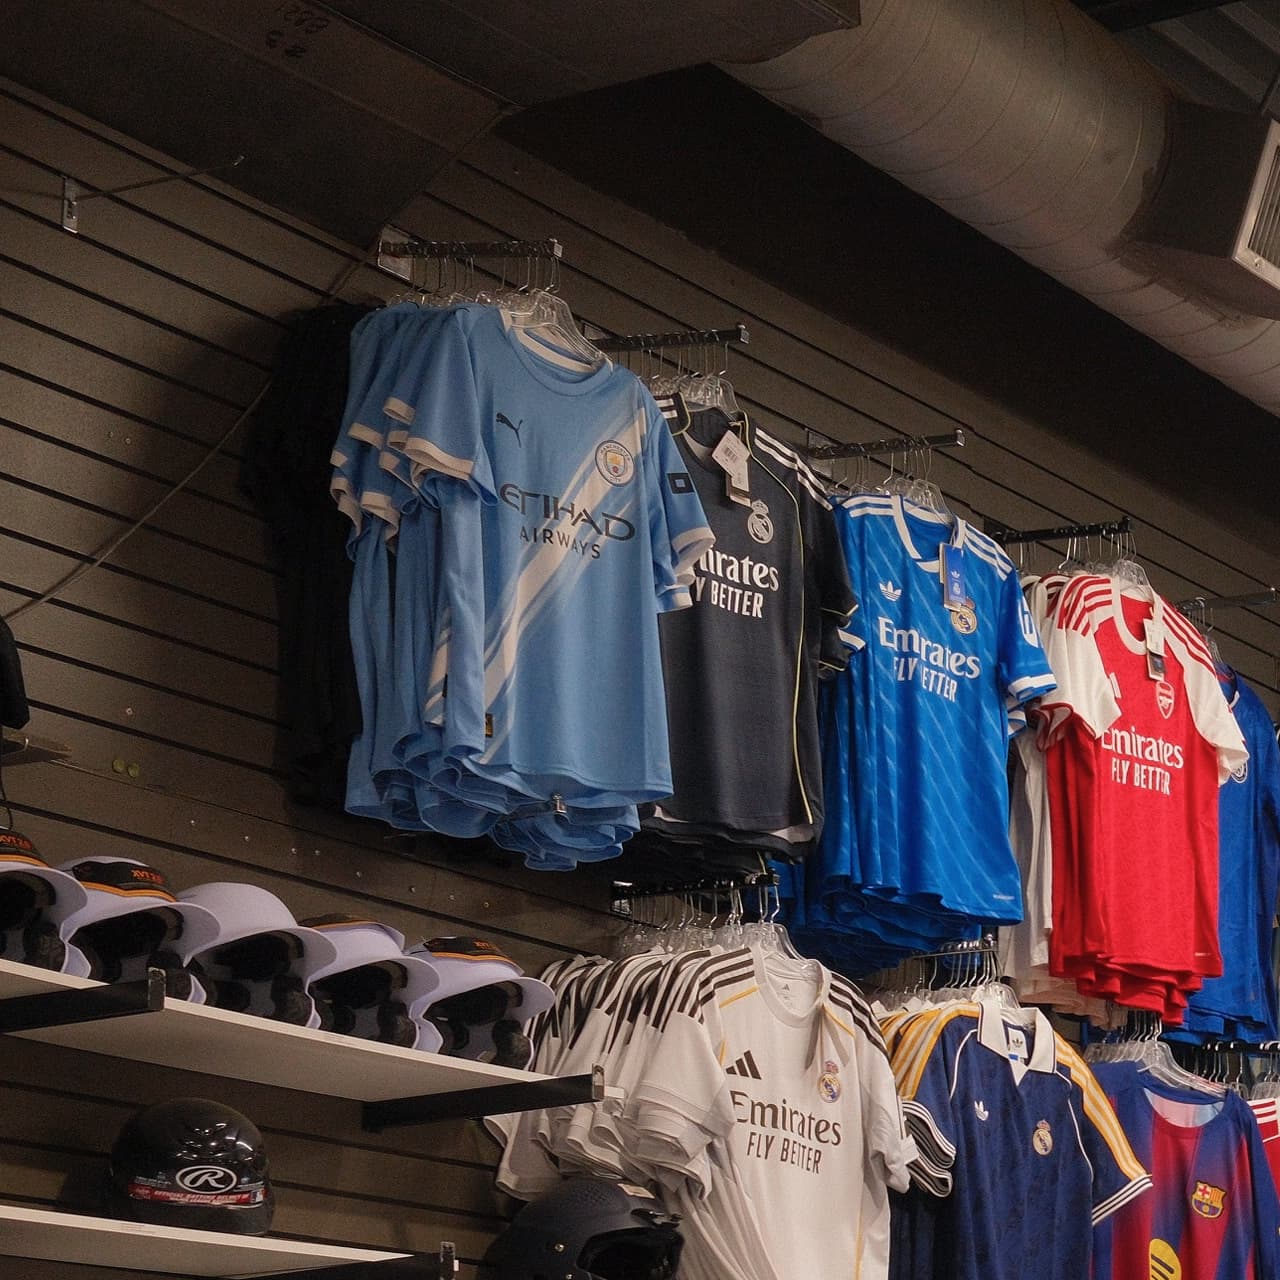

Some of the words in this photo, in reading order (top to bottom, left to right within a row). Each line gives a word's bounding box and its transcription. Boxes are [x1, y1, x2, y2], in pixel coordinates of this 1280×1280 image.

[500, 482, 636, 542] ETIHAD
[519, 525, 601, 560] AIRWAYS
[711, 580, 764, 619] BETTER
[1101, 725, 1184, 769] Emirates
[1111, 757, 1130, 785] FLY
[729, 1089, 842, 1146] Emirates
[747, 1131, 775, 1160] FLY
[780, 1137, 822, 1175] BETTER
